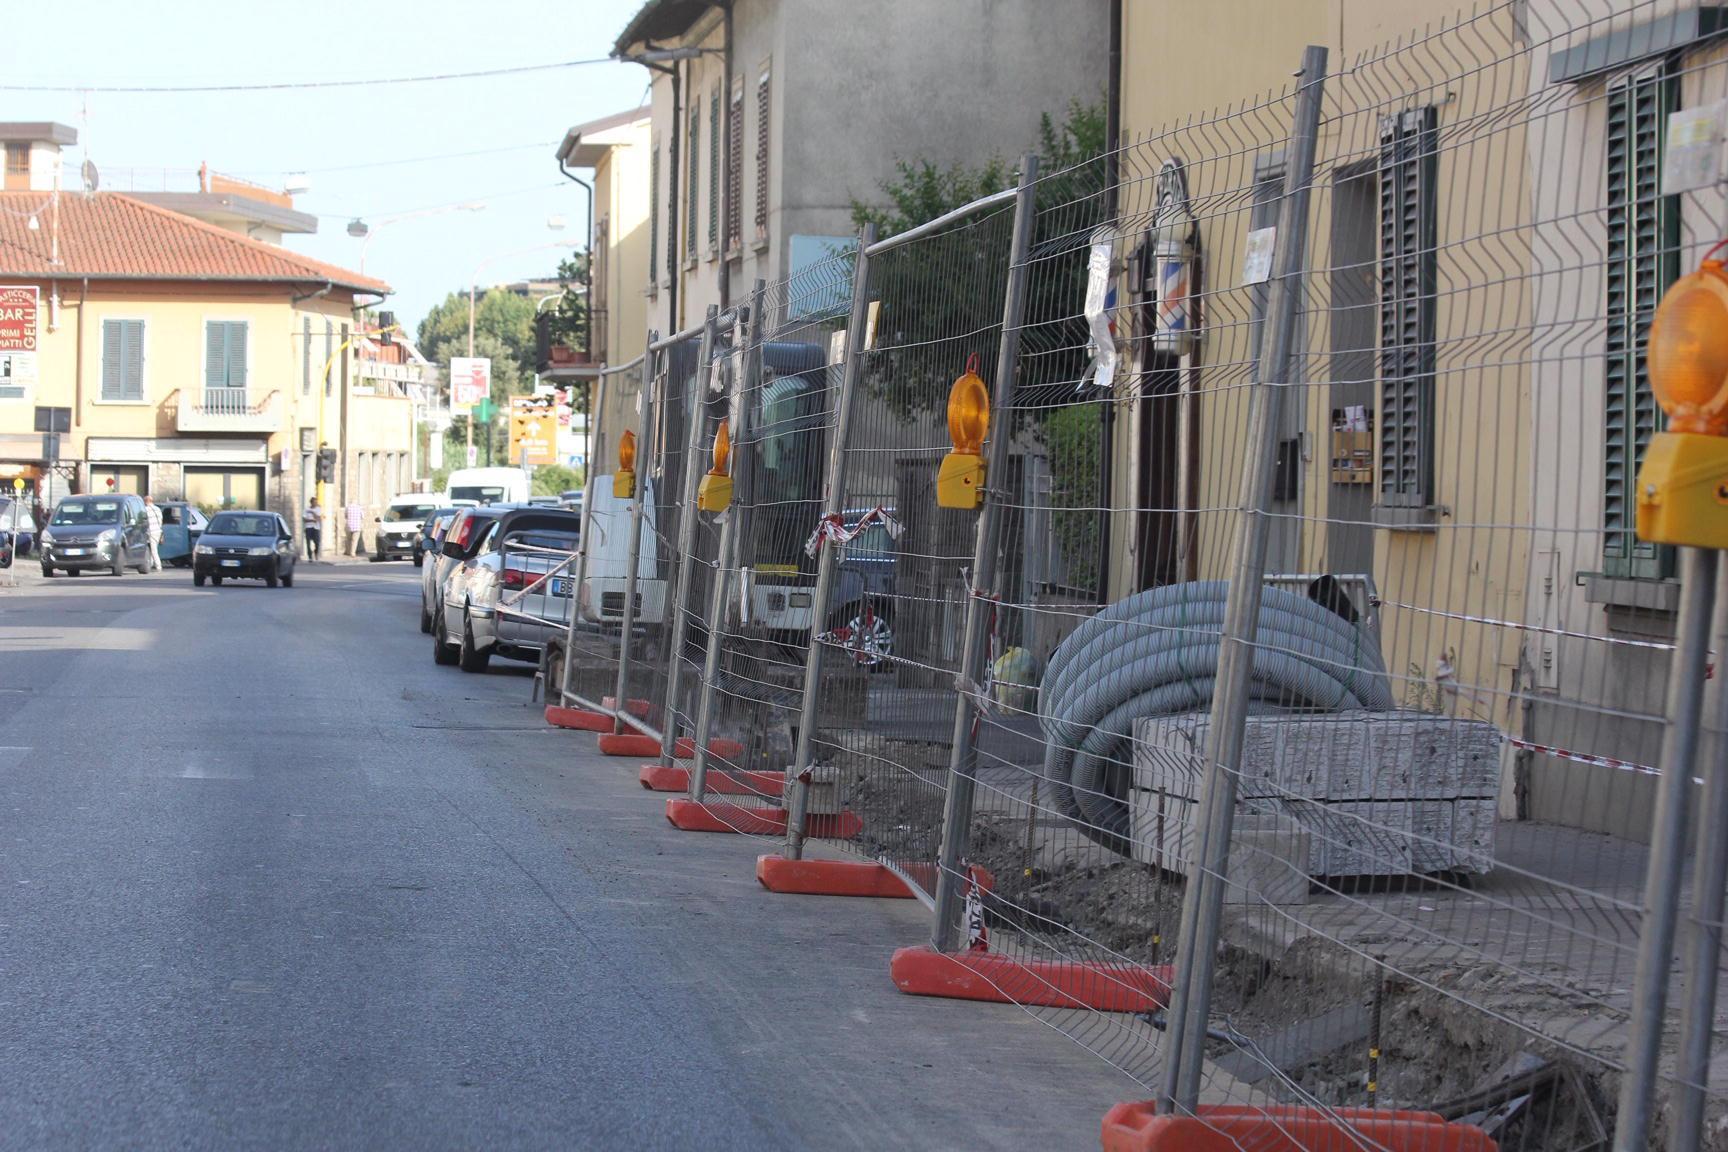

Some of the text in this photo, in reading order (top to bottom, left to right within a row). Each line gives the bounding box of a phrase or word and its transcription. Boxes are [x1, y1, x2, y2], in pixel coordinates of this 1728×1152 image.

[0, 290, 36, 304] ASTICCERIA
[0, 329, 20, 338] RIMI
[23, 308, 36, 349] GELLI
[0, 339, 22, 348] IATTI
